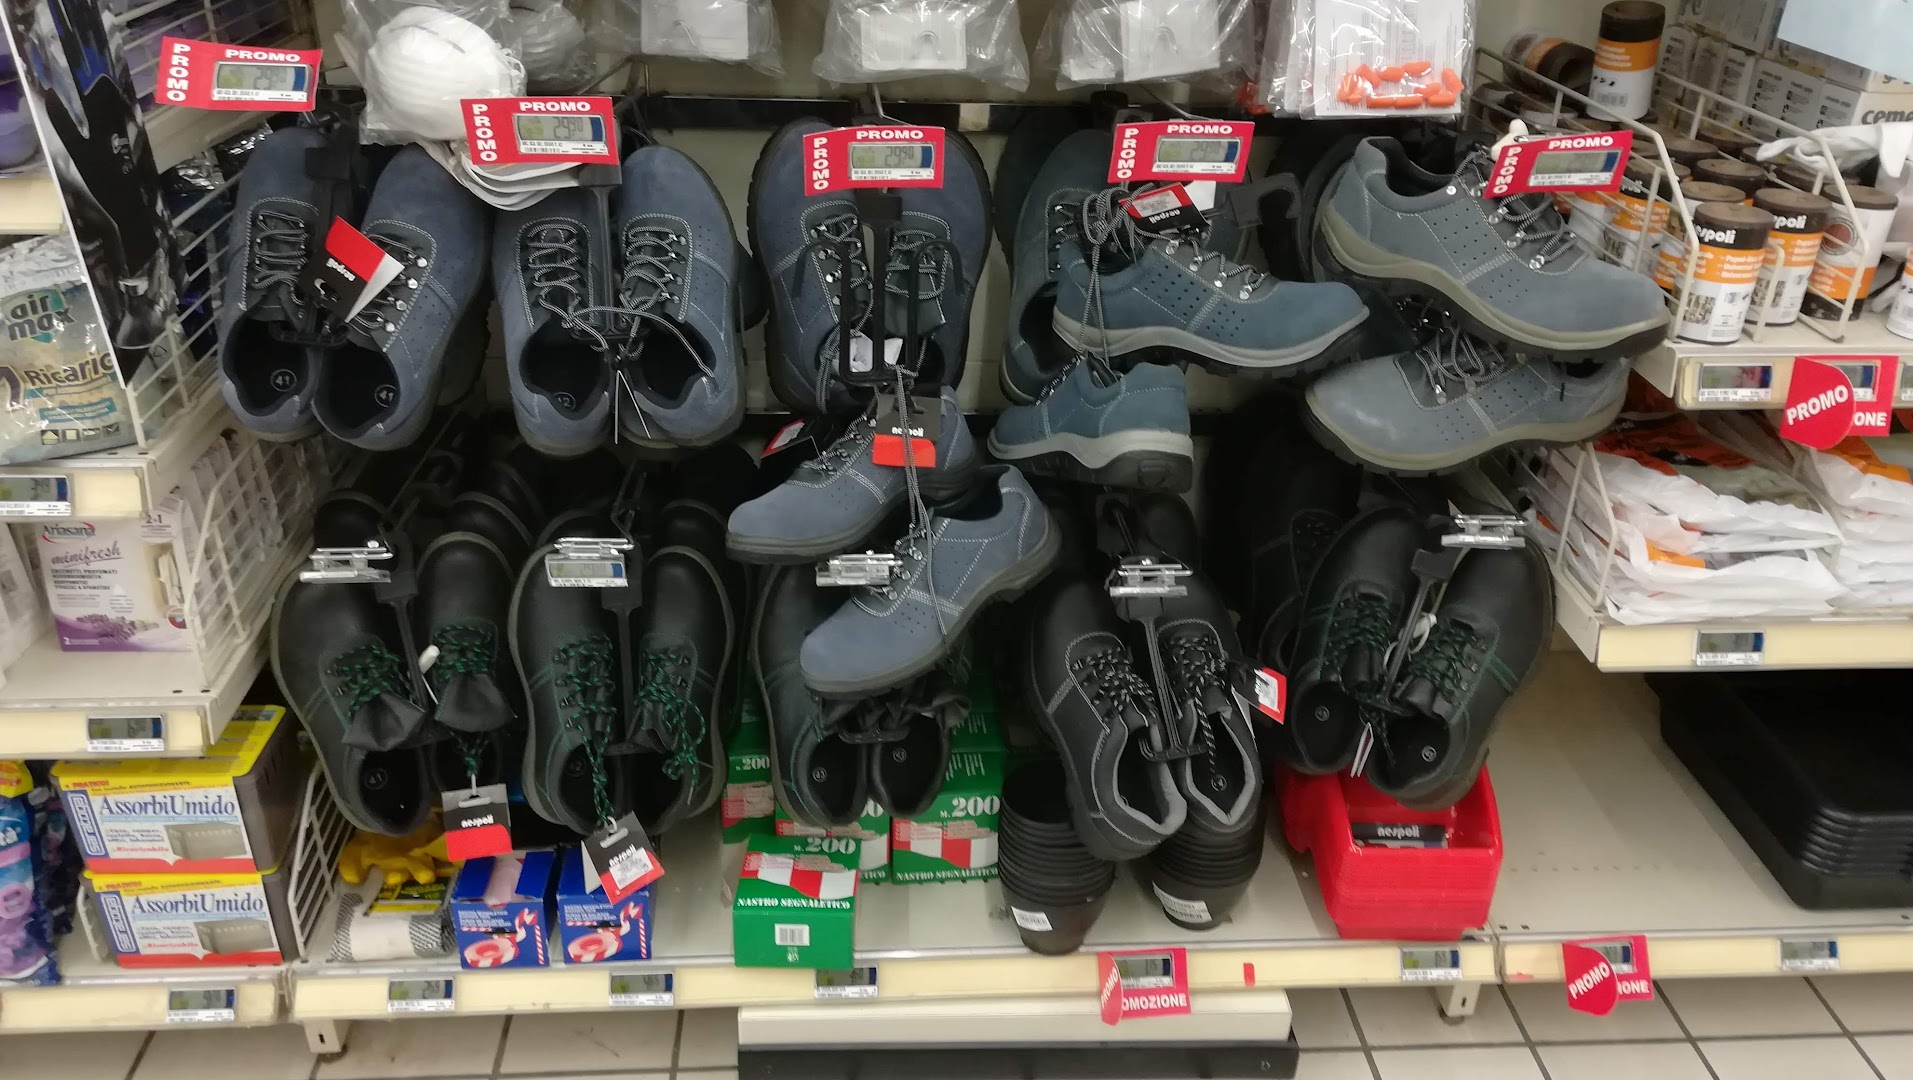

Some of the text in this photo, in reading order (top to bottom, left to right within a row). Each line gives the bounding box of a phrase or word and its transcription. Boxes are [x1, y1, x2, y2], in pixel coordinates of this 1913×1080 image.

[225, 49, 301, 62] PROMO
[167, 43, 191, 101] PROMO
[518, 101, 592, 112] PROMO
[471, 103, 498, 162] PROMO
[855, 129, 924, 140] PROMO
[1166, 124, 1233, 135] PROMO
[1548, 135, 1614, 150] PROMO
[1116, 127, 1140, 179] PROMO
[813, 136, 830, 191] PROMO
[1493, 146, 1523, 194] PROMO
[1149, 208, 1181, 225] nespoli
[1773, 214, 1808, 230] poli
[1694, 224, 1737, 245] espoli
[11, 294, 50, 320] air
[8, 306, 77, 342] max
[1786, 384, 1849, 426] PROMO
[891, 426, 924, 438] nepoli
[43, 523, 96, 537] Ariasana
[51, 540, 122, 566] minifresh
[742, 755, 771, 771] 200
[100, 794, 236, 817] AssorbiUmido
[951, 795, 1001, 818] 200
[461, 814, 495, 829] nespoli
[1377, 825, 1421, 840] nespoli
[608, 843, 638, 868] nespoli
[806, 837, 857, 855] 200
[897, 871, 934, 881] NASTRO
[131, 892, 264, 915] AssorbiUmido
[736, 897, 851, 910] NASTRO SEGNALETICO
[1100, 966, 1119, 1010] PROMO
[1568, 961, 1611, 1000] PROMO
[1121, 992, 1188, 1011] OMOZIONE
